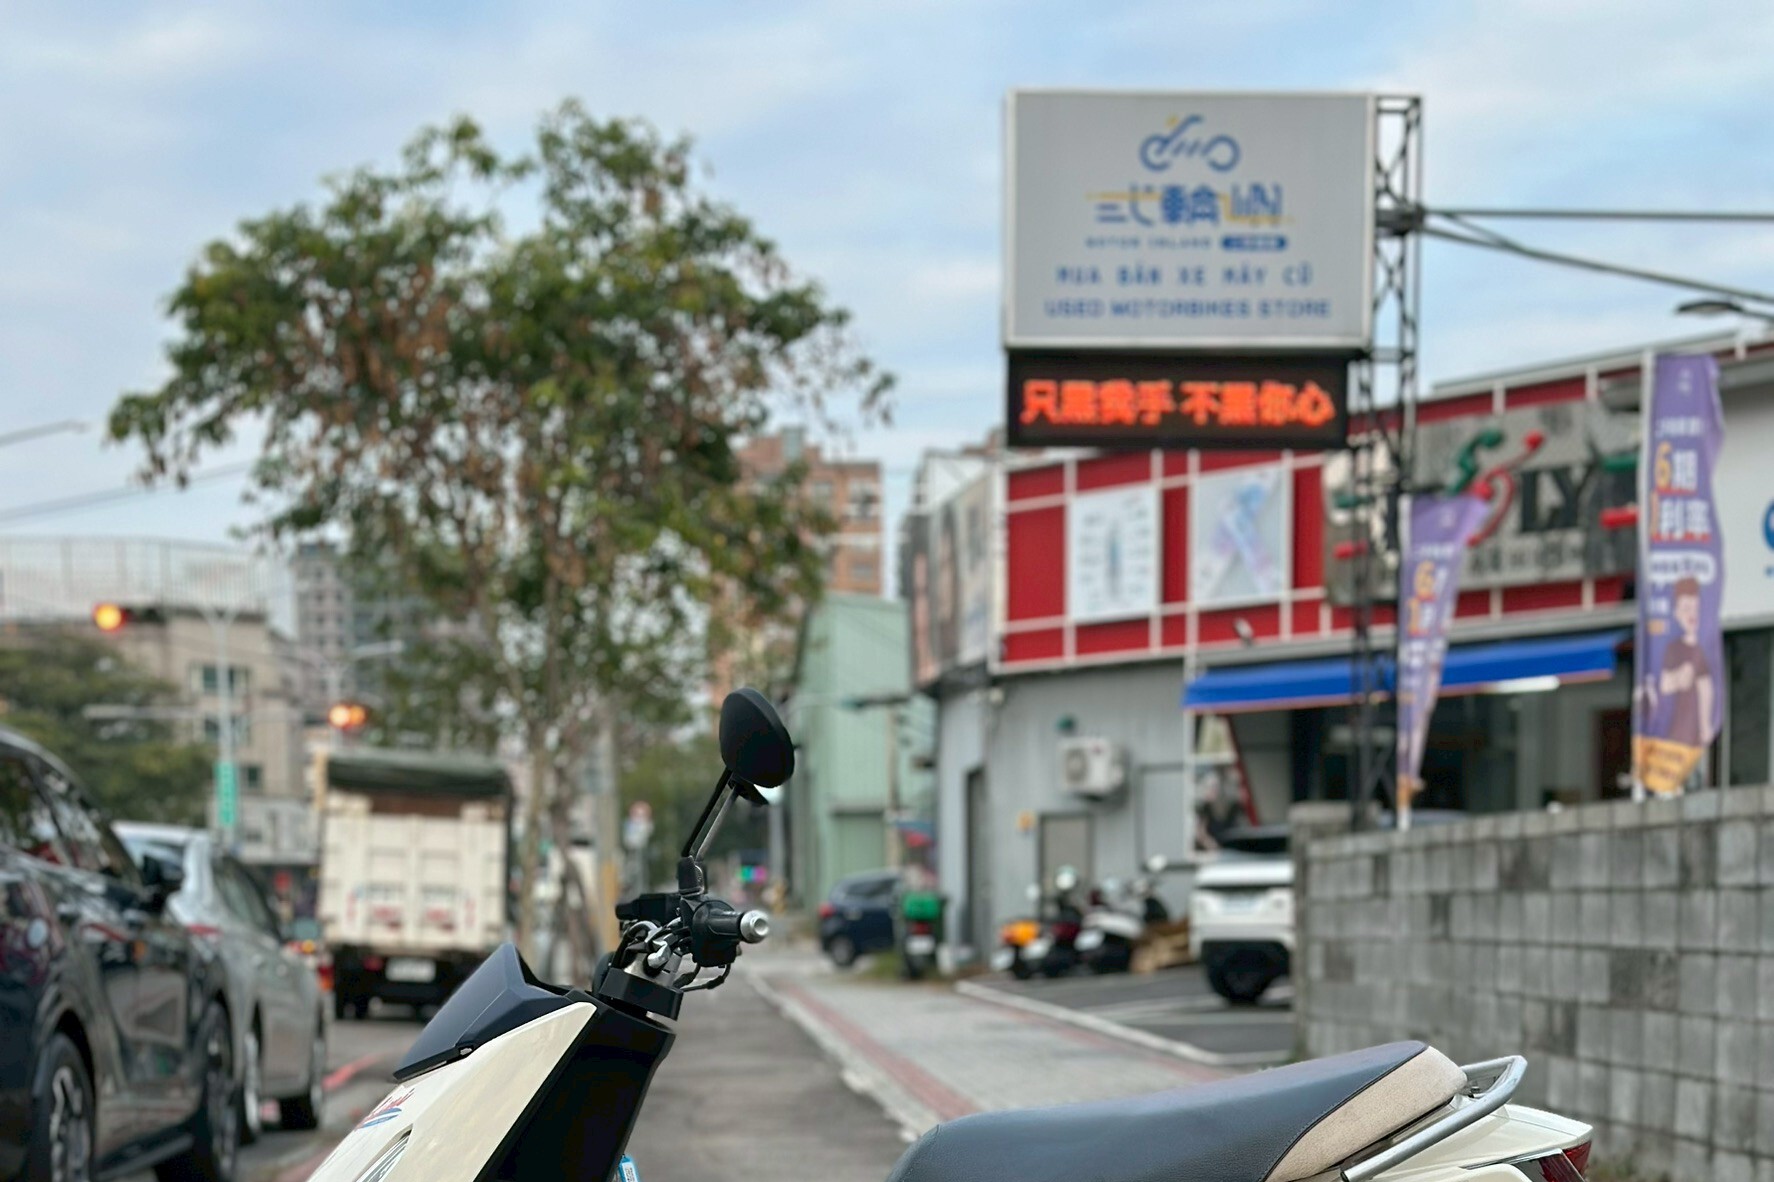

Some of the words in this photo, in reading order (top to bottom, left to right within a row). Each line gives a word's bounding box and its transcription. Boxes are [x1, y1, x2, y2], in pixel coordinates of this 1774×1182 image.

[1045, 300, 1103, 318] USED
[1111, 300, 1249, 318] MOTORBIKES
[1258, 300, 1331, 318] STORE
